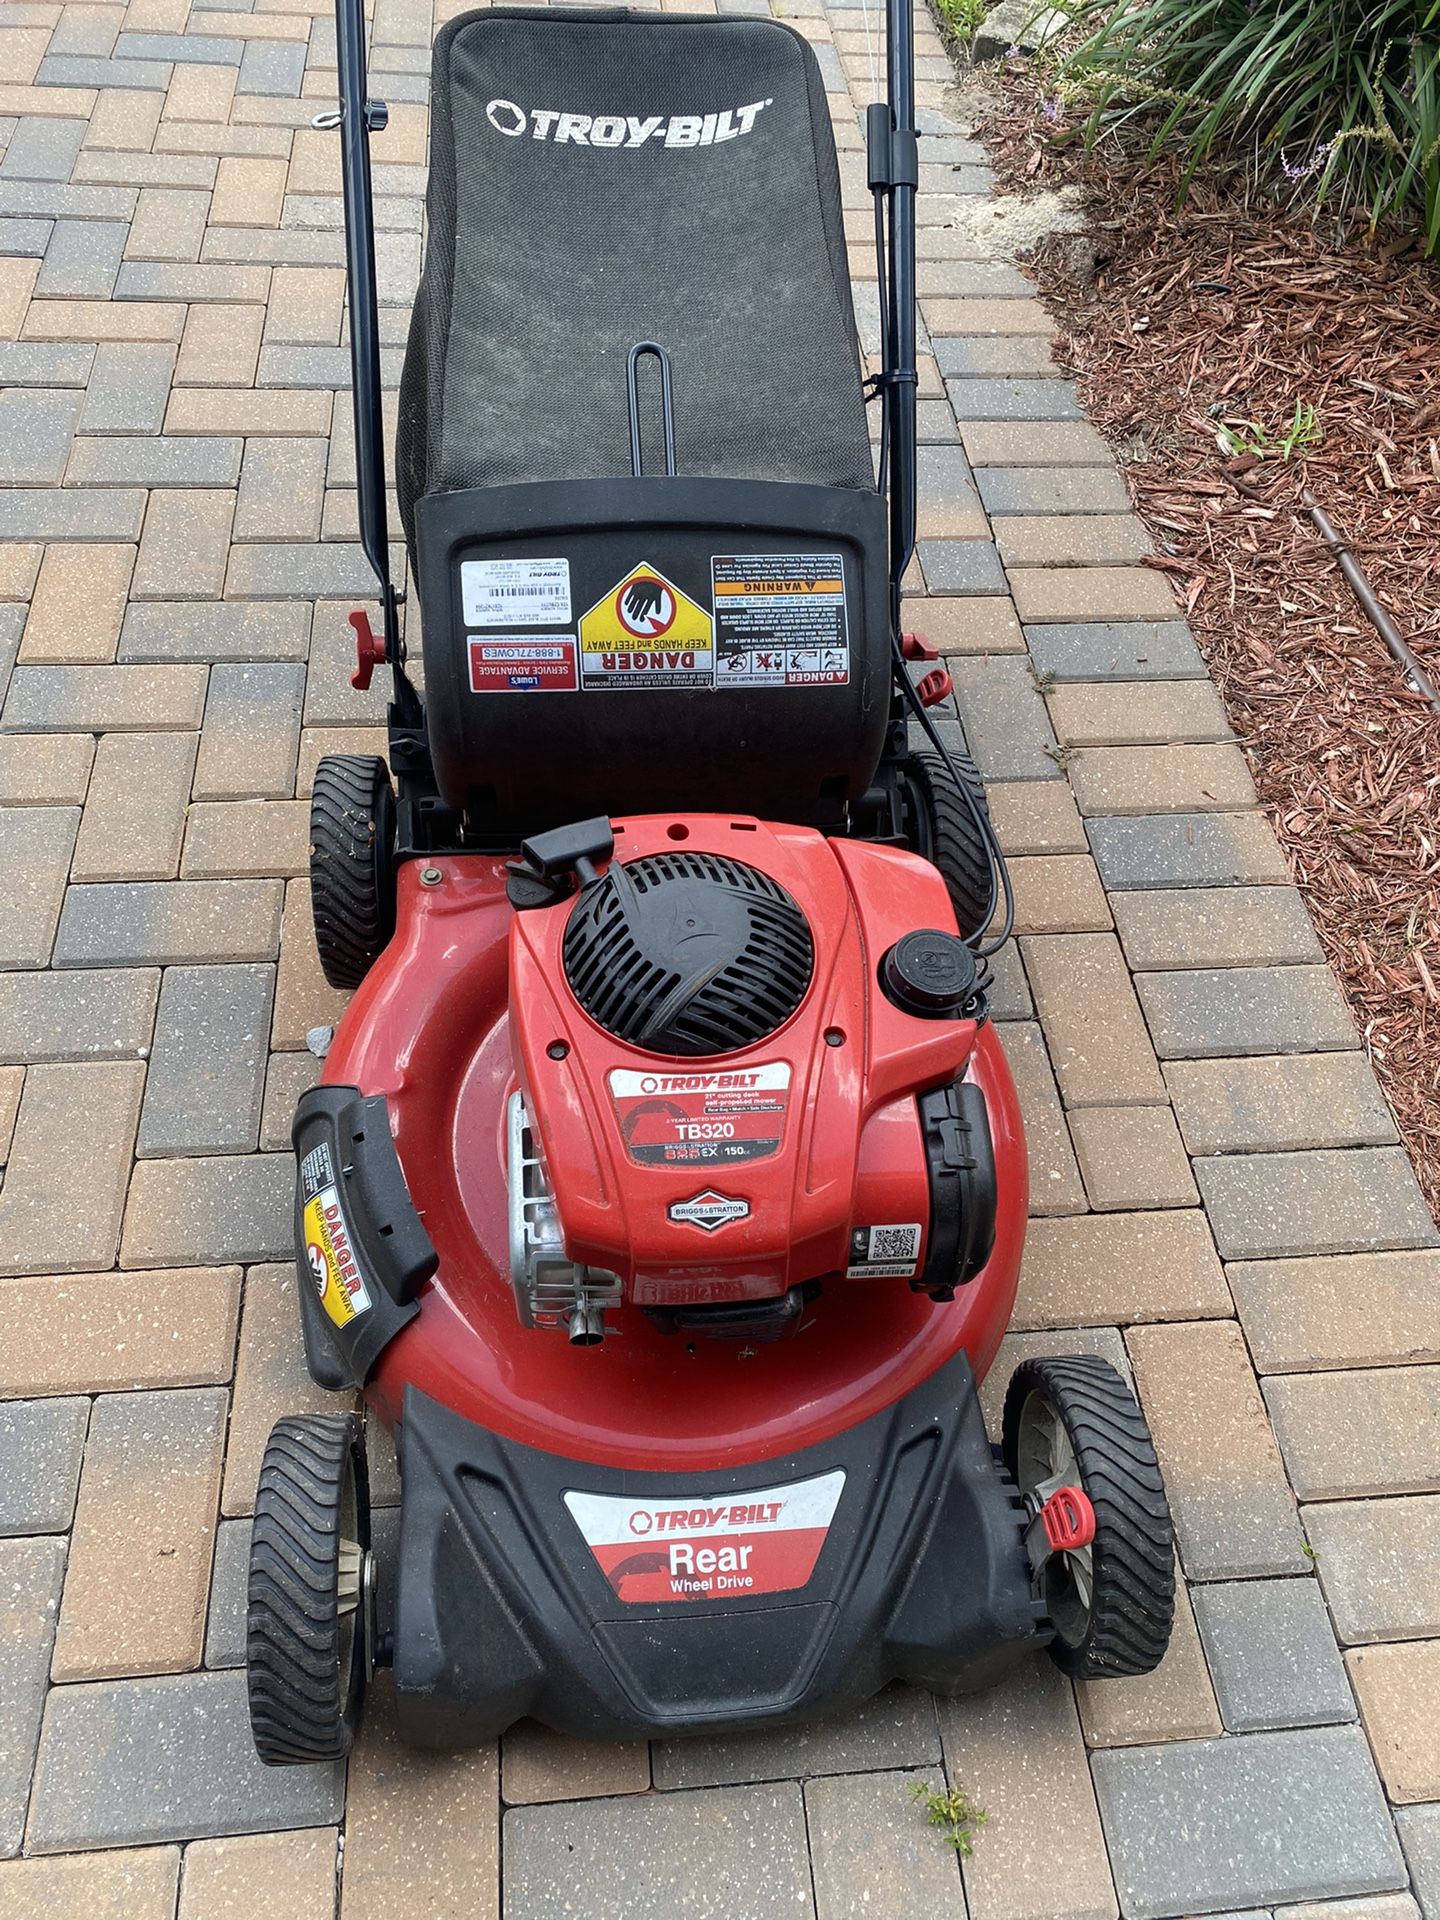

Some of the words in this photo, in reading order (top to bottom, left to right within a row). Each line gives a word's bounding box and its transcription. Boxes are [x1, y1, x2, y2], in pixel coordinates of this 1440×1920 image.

[530, 100, 765, 148] TROY-BILT
[743, 582, 802, 592] WARNING
[586, 641, 611, 650] AWAY
[613, 641, 634, 649] FEET
[637, 641, 651, 649] and
[653, 640, 682, 648] HANDS
[684, 639, 706, 648] KEEP
[484, 648, 561, 658] 1-888-77LOWES
[601, 652, 695, 670] DANGER
[479, 666, 530, 675] ADVANTAGE
[532, 666, 568, 675] SERVICE
[788, 672, 834, 682] DANGER
[659, 1073, 760, 1092] TROY-BILT
[705, 1099, 752, 1107] self-propelled
[675, 1122, 735, 1139] TB320
[324, 1203, 362, 1297] DANGER
[313, 1201, 325, 1221] KEEP
[319, 1222, 331, 1252] HANDS
[327, 1252, 335, 1268] and
[331, 1266, 343, 1288] FEET
[338, 1288, 354, 1314] AWAY
[654, 1502, 782, 1532] TROY-BILT
[669, 1543, 753, 1576] Rear
[670, 1577, 713, 1593] Wheel
[717, 1576, 753, 1589] Drive
